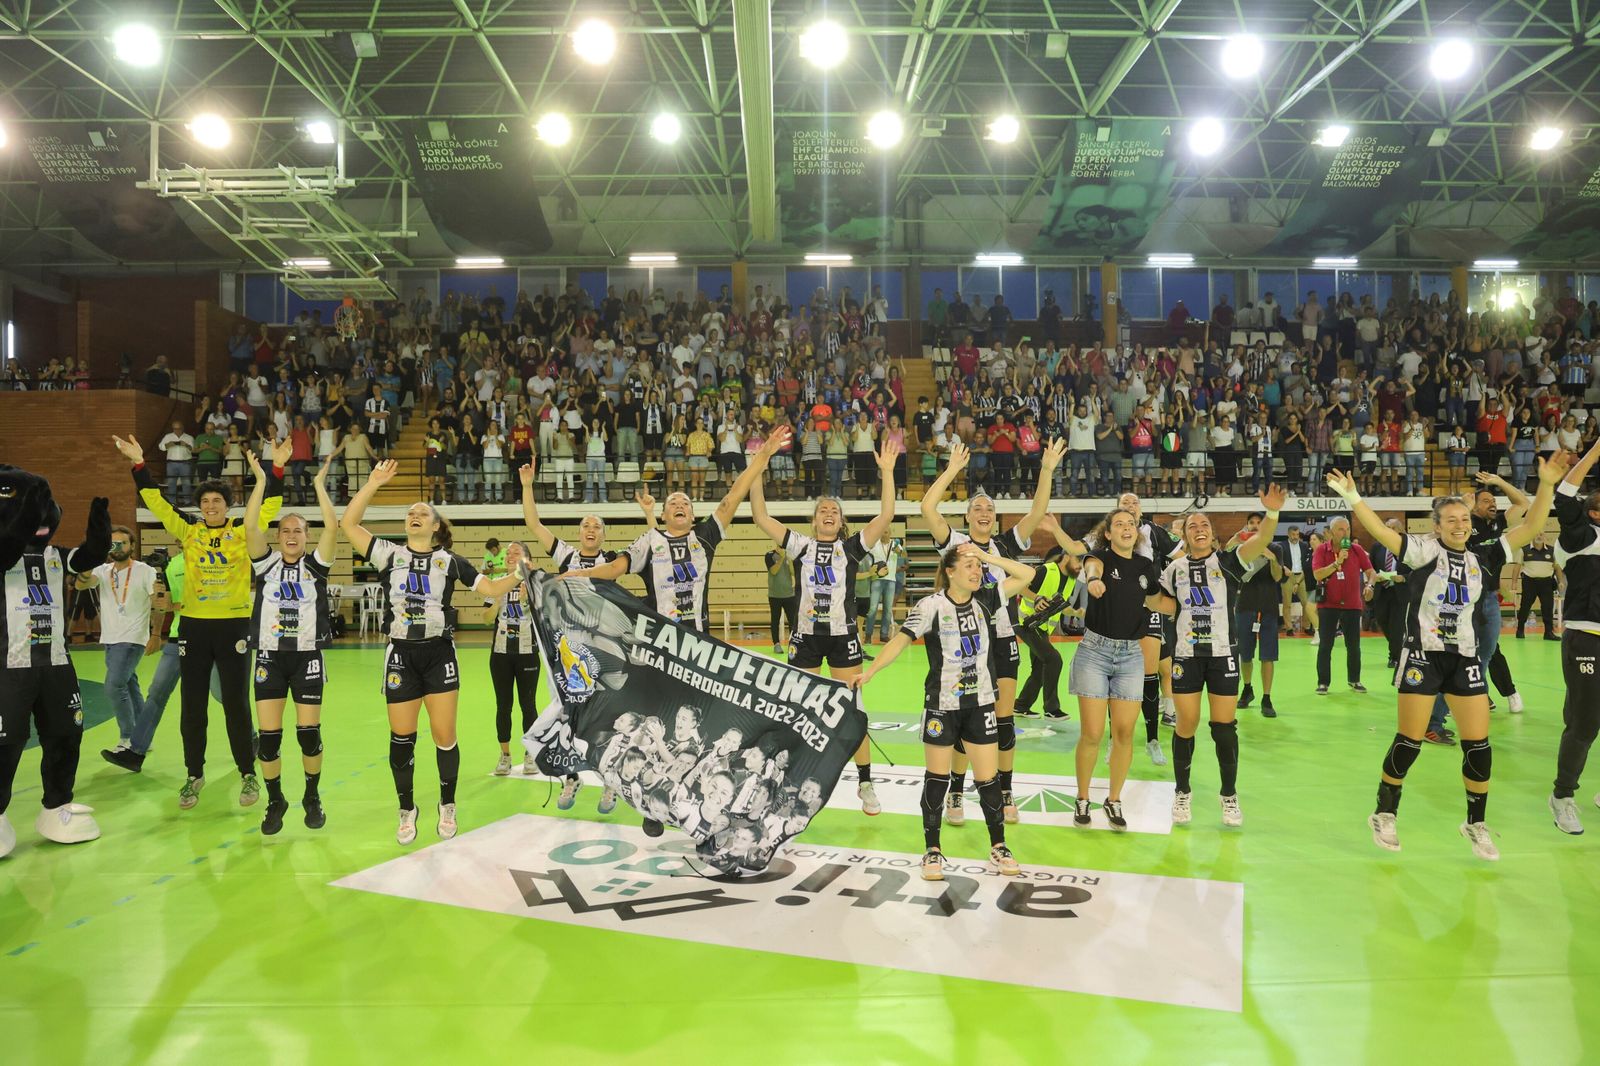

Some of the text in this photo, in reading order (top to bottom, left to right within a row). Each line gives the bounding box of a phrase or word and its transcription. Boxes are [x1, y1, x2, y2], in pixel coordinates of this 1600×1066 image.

[417, 139, 499, 149] HERRERA GÓMEZ
[1350, 136, 1378, 145] ARLOS
[427, 148, 455, 156] OROS
[814, 146, 873, 154] CHAMPIONS
[1074, 148, 1113, 156] JUEGOS
[1376, 144, 1406, 154] PÉREZ
[33, 152, 93, 160] PLATA EN EL
[1335, 152, 1374, 160] BRONCE
[38, 160, 101, 168] EUROBASKET
[424, 162, 504, 171] JUDO ADAPTADO
[1072, 163, 1112, 171] HOCKEY
[58, 167, 101, 175] FRANCIA
[102, 167, 117, 175] DE
[117, 166, 138, 175] 1999
[1070, 170, 1102, 178] SOBRE
[46, 174, 111, 183] BALONCESTO
[1321, 180, 1381, 188] BALONMANO
[1297, 498, 1347, 510] SALIDA
[672, 546, 687, 561] 17
[817, 552, 831, 564] 57
[413, 558, 427, 571] 13
[31, 566, 41, 581] 8
[282, 568, 298, 582] 18
[1193, 570, 1202, 584] 6
[1450, 563, 1464, 581] 27
[509, 591, 519, 602] 10
[960, 614, 977, 633] 20
[1150, 612, 1160, 624] 23
[848, 640, 859, 655] 57
[307, 659, 321, 675] 18
[444, 661, 456, 678] 13
[1227, 656, 1237, 672] 6
[1579, 662, 1595, 675] 68
[633, 612, 854, 730] CAMPEONAS
[1465, 664, 1482, 682] 27
[630, 644, 666, 673] LIGA
[753, 697, 830, 753] 2022/2023
[983, 710, 997, 729] 20
[1018, 869, 1101, 886] RUGS
